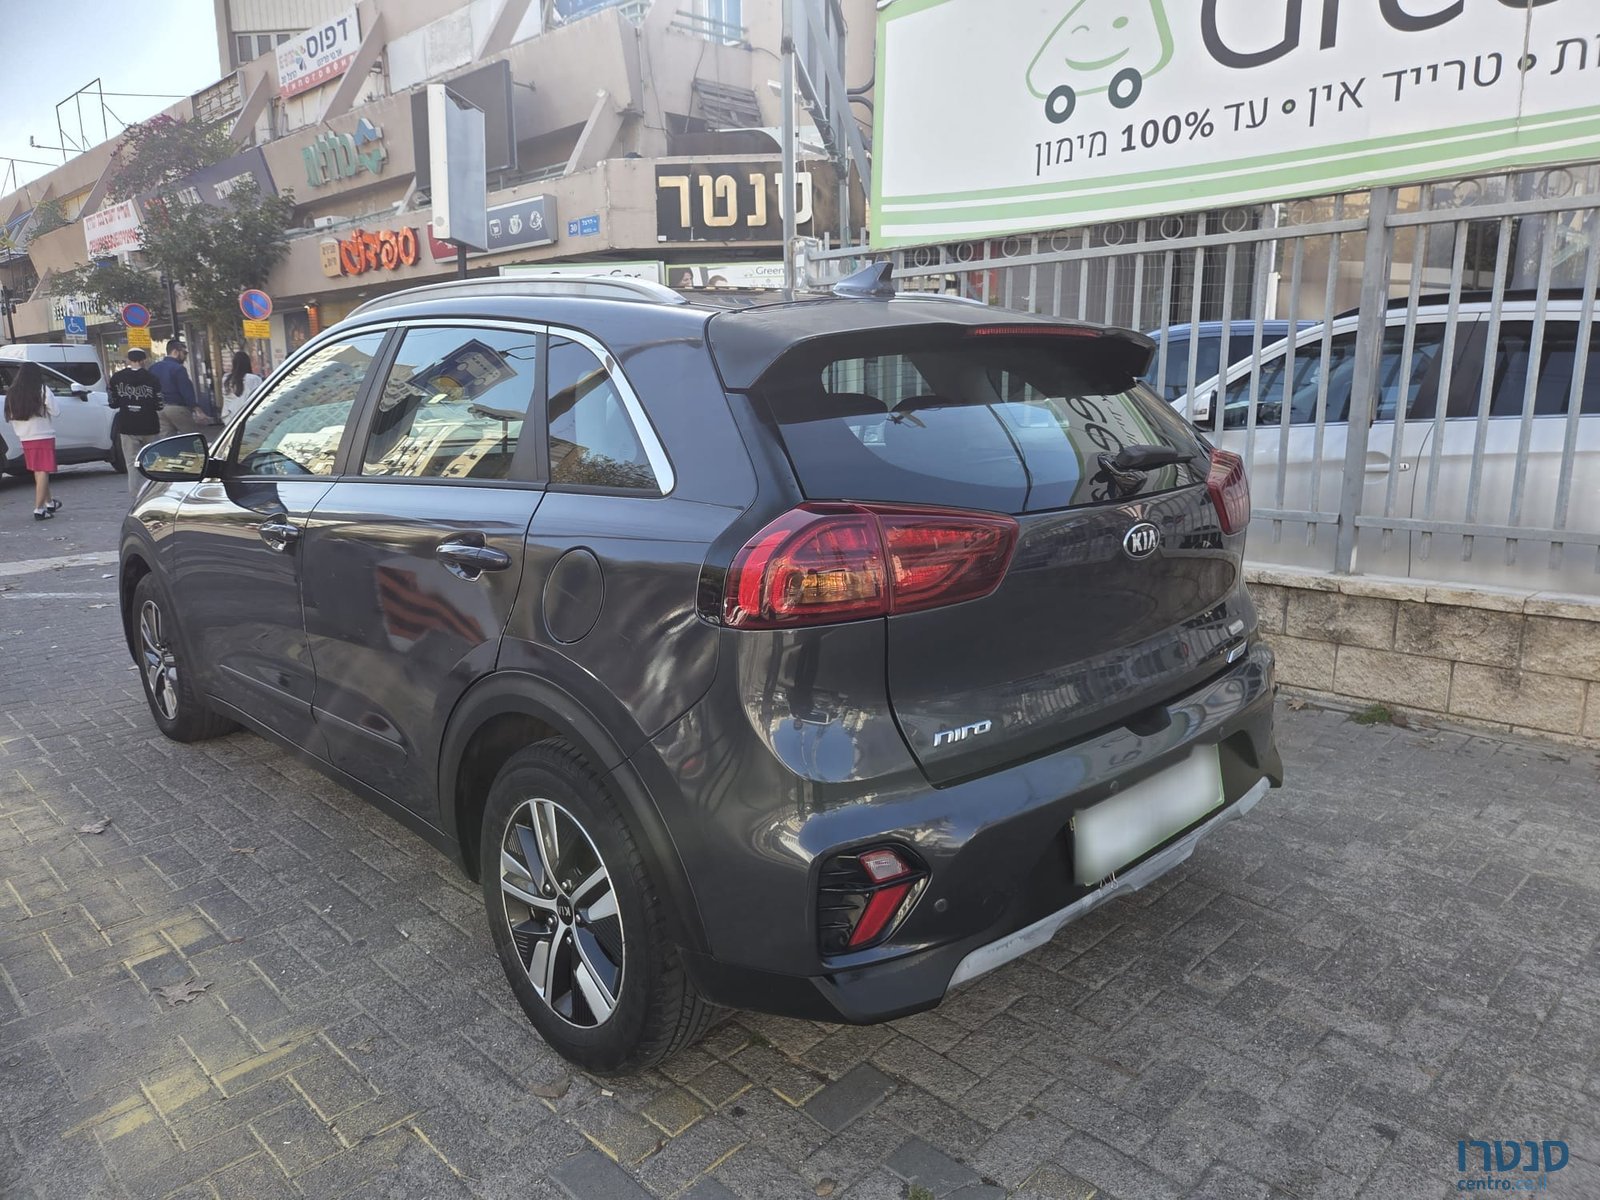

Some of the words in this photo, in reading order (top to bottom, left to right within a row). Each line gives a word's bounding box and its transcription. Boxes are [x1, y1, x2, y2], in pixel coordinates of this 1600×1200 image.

[305, 17, 348, 59] דפוס
[1382, 52, 1503, 102] טרייד
[1223, 96, 1269, 132] עד
[1308, 77, 1366, 127] אין
[1121, 108, 1214, 152] 100%
[1035, 130, 1107, 176] מימון
[569, 223, 578, 234] 30
[1131, 528, 1157, 554] KIA
[933, 719, 993, 748] niro
